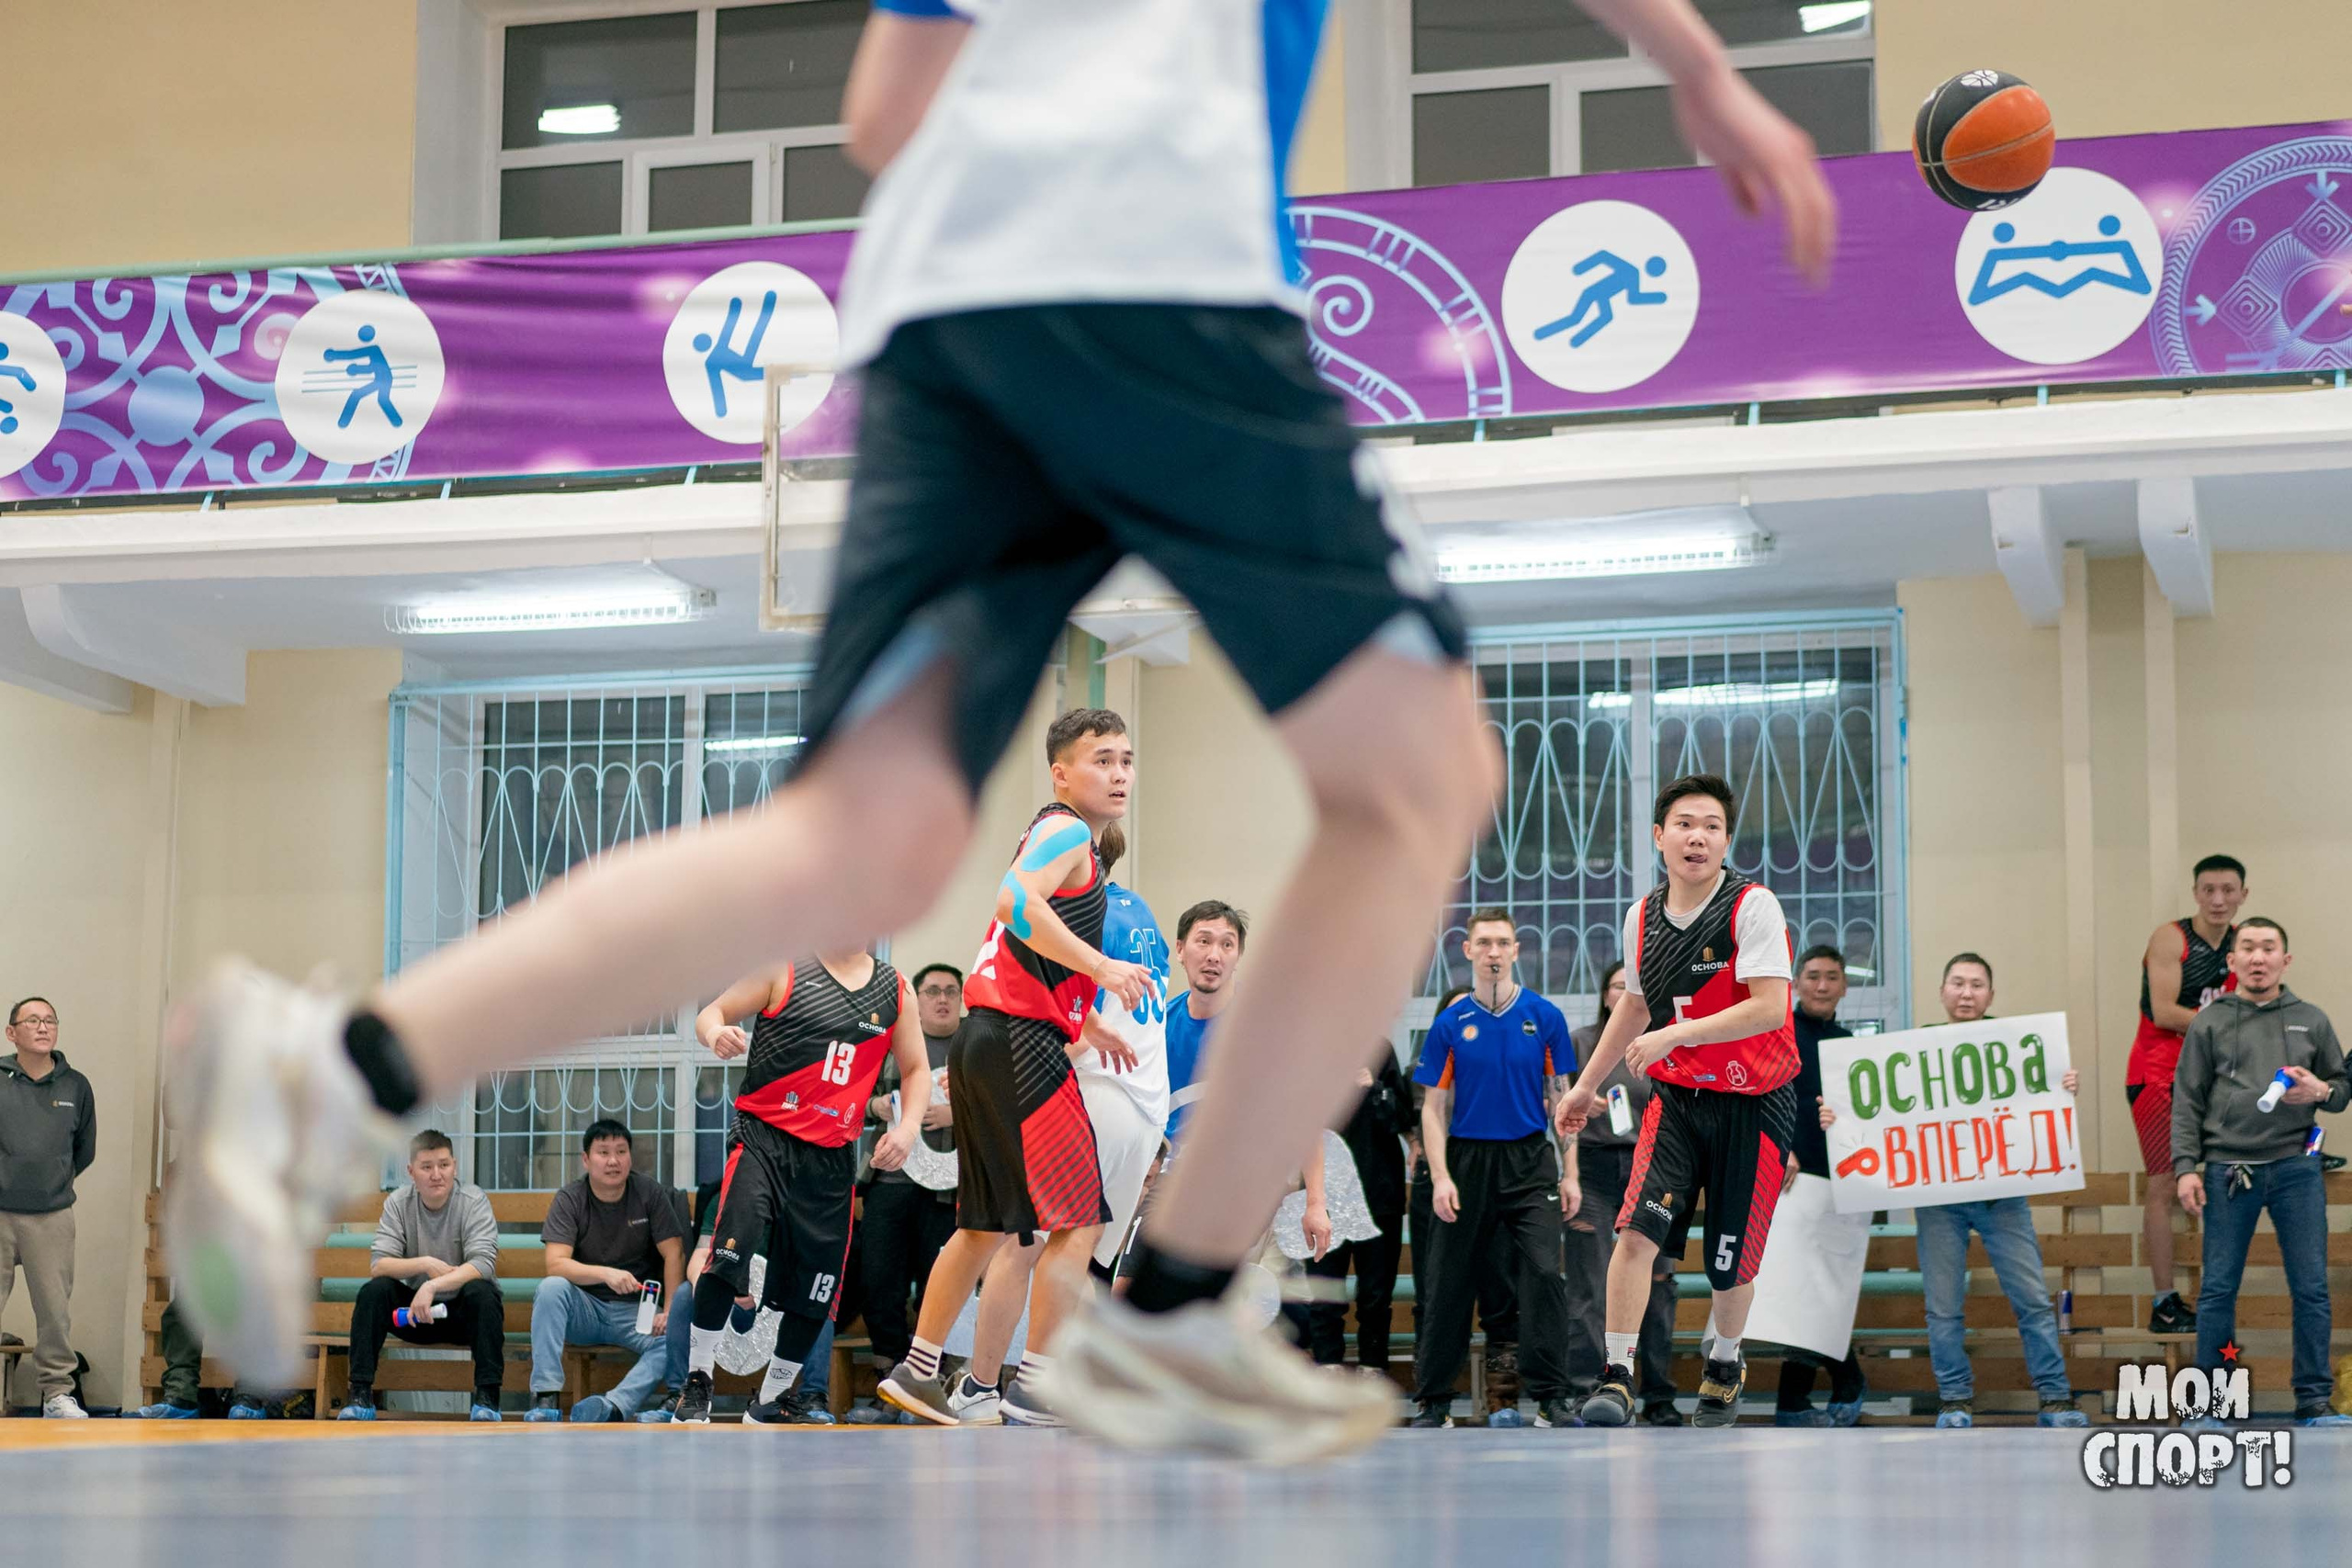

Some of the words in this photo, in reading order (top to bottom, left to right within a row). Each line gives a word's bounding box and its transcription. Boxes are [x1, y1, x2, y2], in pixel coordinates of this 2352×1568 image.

[1691, 962, 1729, 972] ОСНОВА
[858, 1021, 887, 1034] ОСНОВА
[821, 1040, 855, 1085] 13
[1883, 1107, 2076, 1188] ВПЕРЁД!
[1715, 1234, 1737, 1271] 5
[809, 1272, 835, 1303] 13
